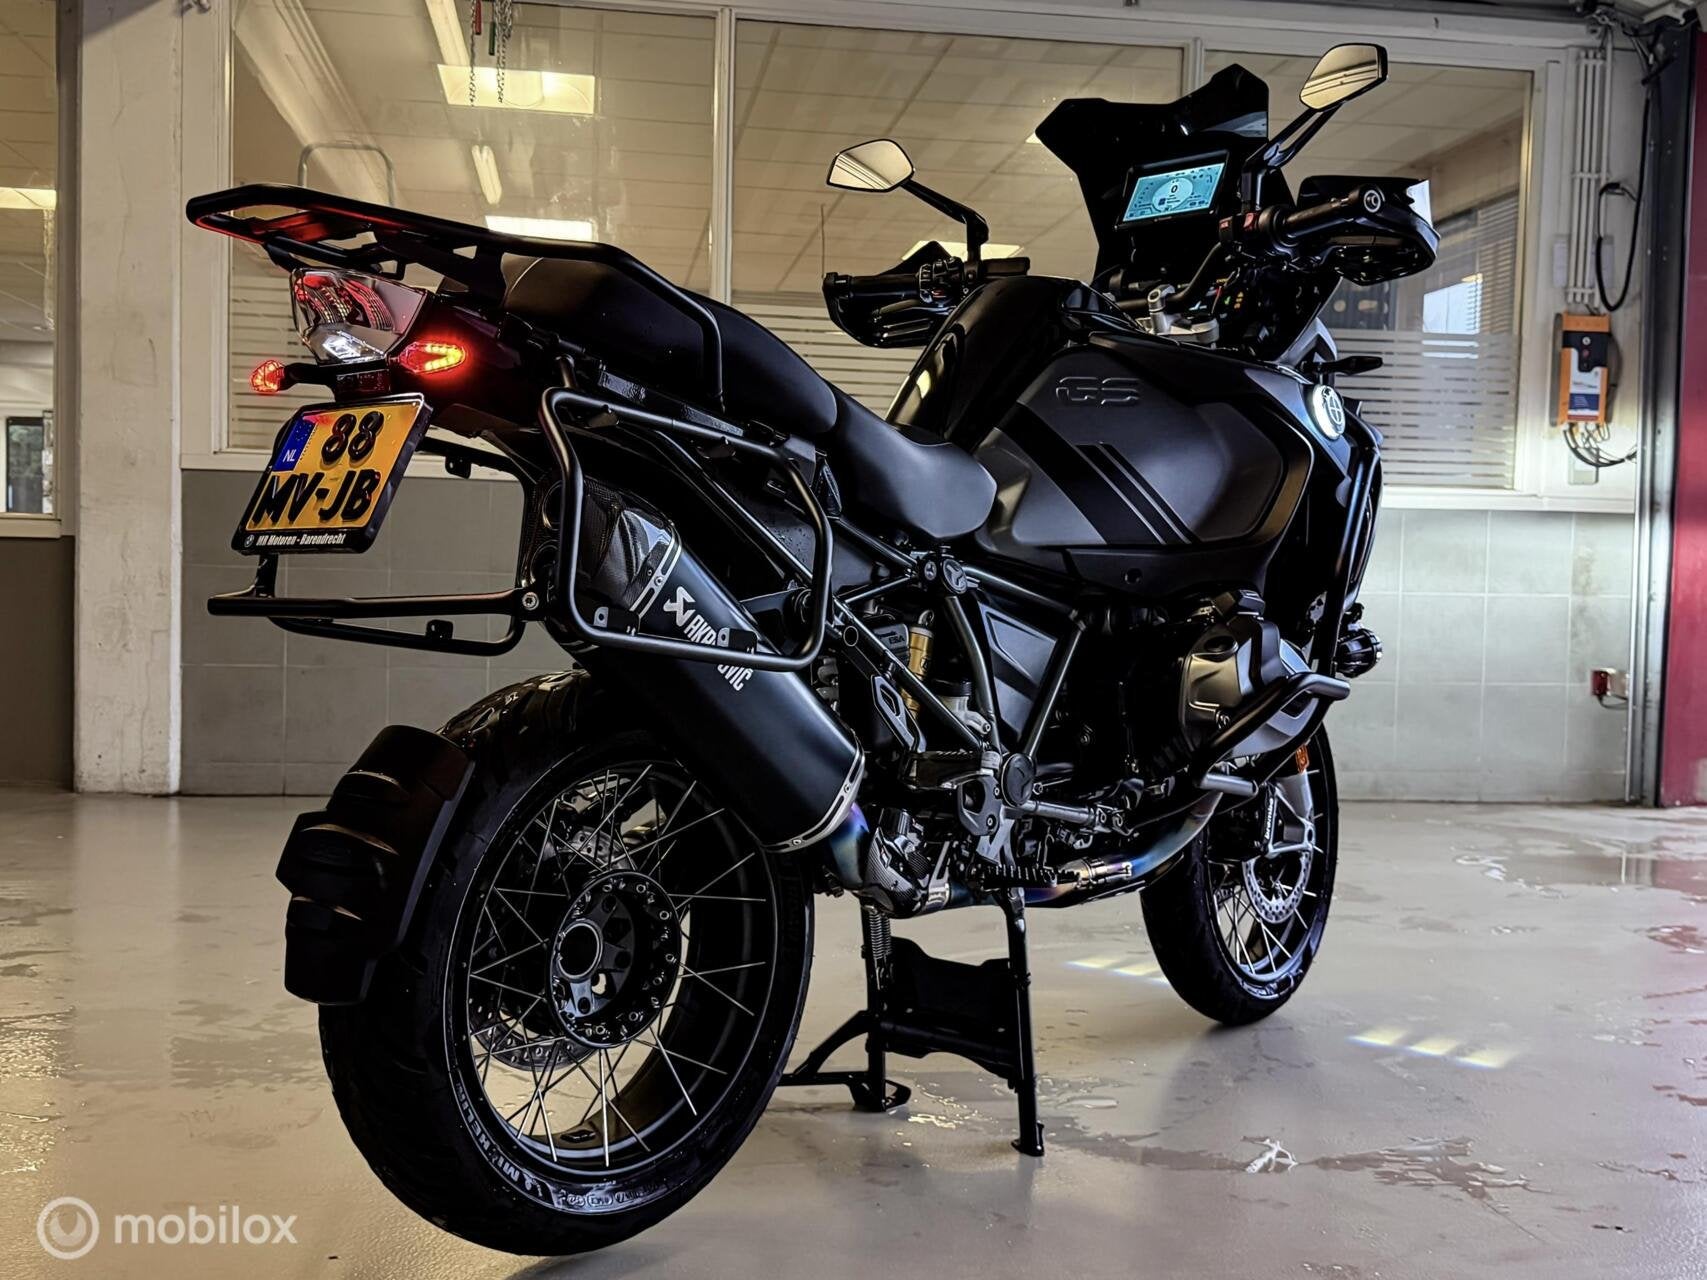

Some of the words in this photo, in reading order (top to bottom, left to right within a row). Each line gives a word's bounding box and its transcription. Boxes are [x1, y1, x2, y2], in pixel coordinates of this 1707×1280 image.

[1170, 184, 1179, 194] 0
[1056, 376, 1140, 406] GS
[321, 411, 385, 466] 88
[282, 449, 296, 462] NL
[251, 468, 382, 524] MV-JB
[267, 534, 298, 546] Motoren
[299, 532, 347, 545] Barendrecht
